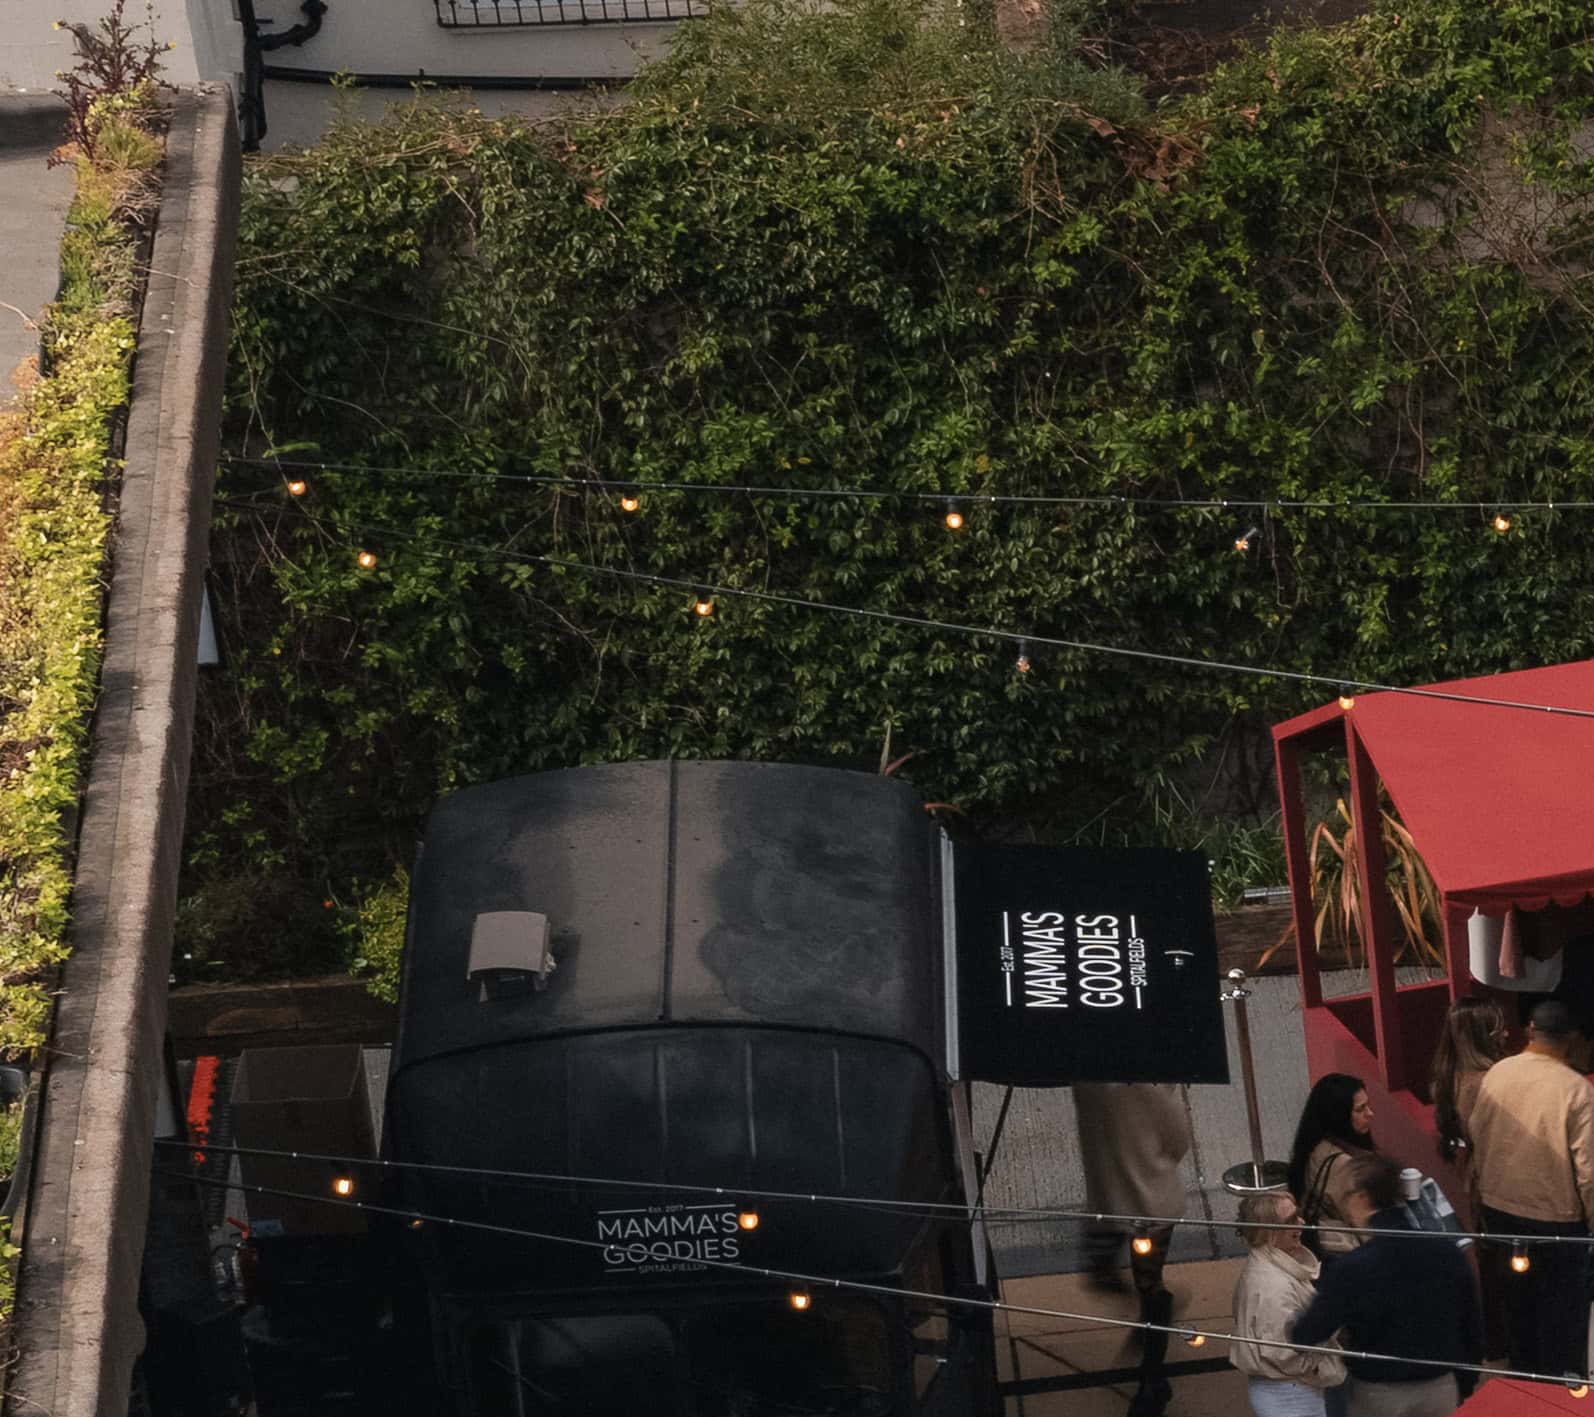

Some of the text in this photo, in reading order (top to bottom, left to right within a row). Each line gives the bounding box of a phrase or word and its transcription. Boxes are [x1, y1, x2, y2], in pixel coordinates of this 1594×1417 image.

[1020, 911, 1069, 1008] MAMMA'S
[1075, 914, 1125, 1008] GOODIES
[1128, 937, 1148, 986] SPITALFIELDS
[598, 1212, 740, 1240] MAMMA'S
[603, 1237, 740, 1264] GOODIES
